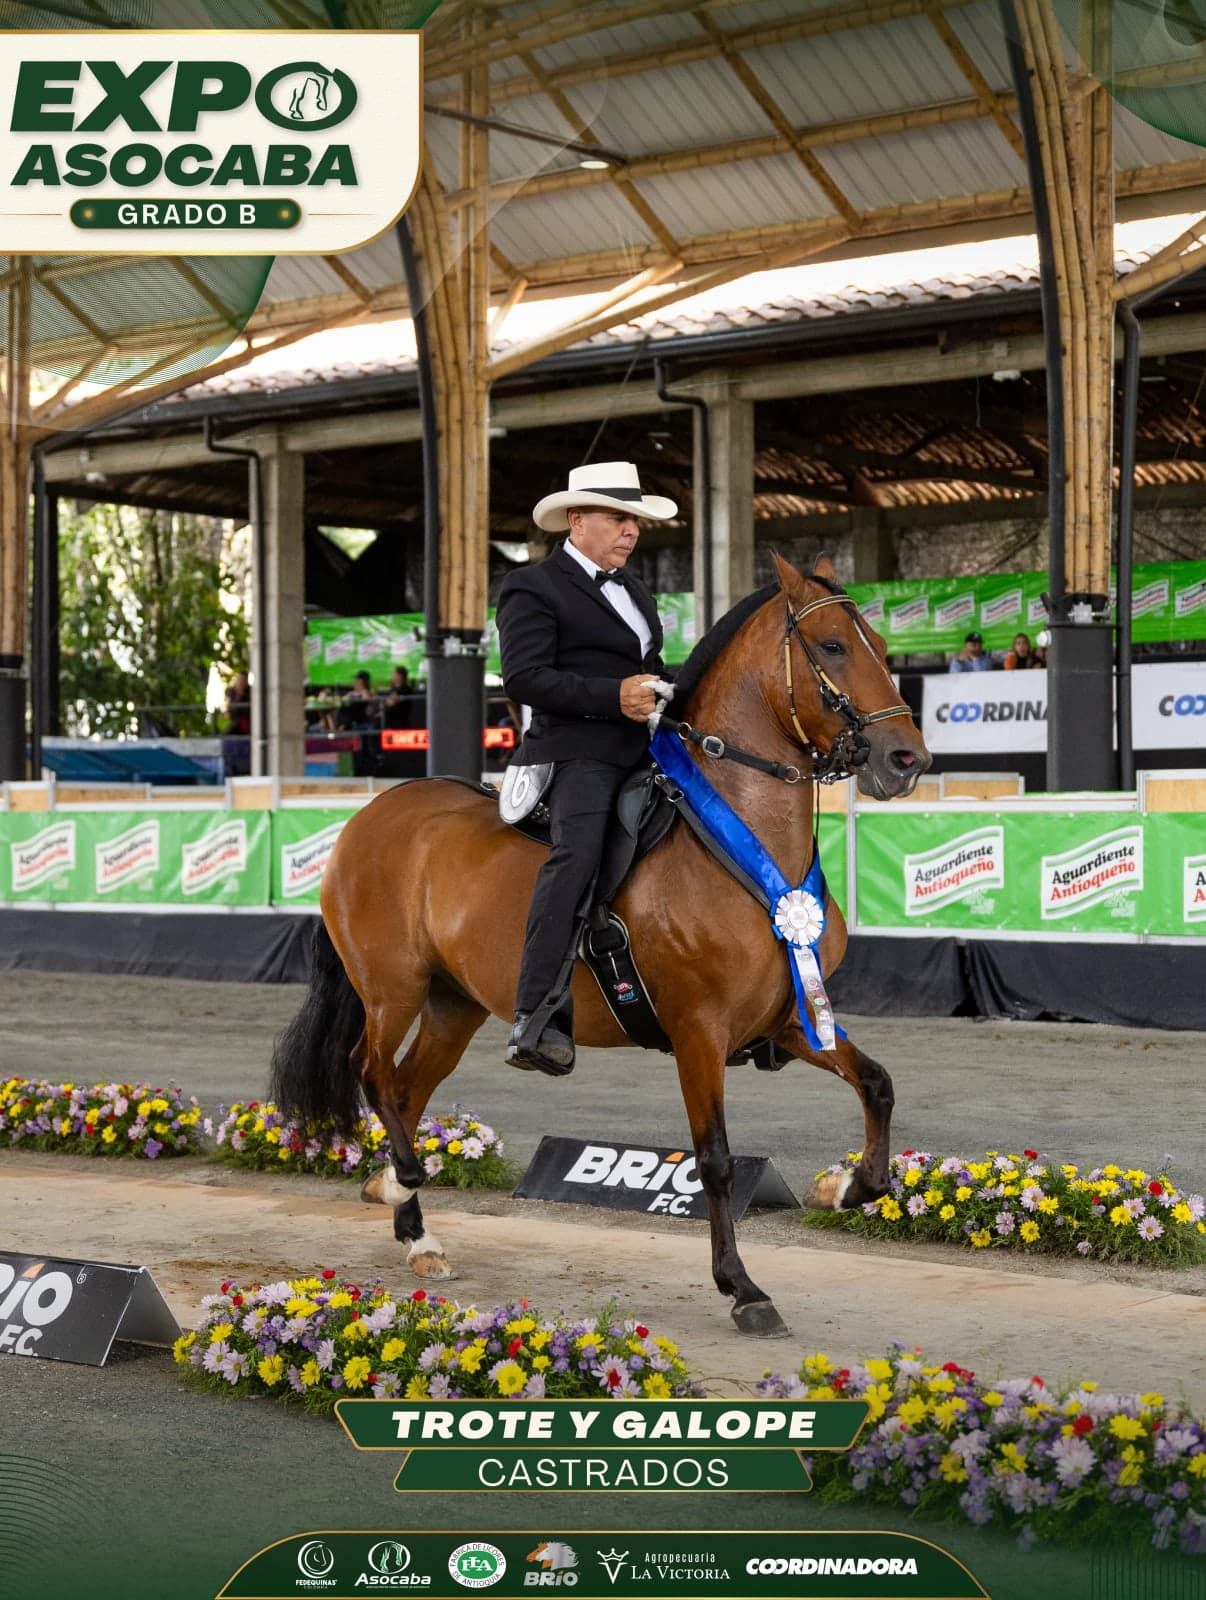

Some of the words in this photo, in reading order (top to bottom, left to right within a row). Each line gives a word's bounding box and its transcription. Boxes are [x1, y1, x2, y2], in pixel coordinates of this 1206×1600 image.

[935, 700, 1048, 723] COORDIN
[914, 845, 993, 883] Aguardiente
[914, 858, 995, 898] Antioqueño
[1050, 858, 1136, 901] Antioqueño
[1052, 845, 1135, 885] Aguardiente
[647, 1193, 694, 1215] F.C.
